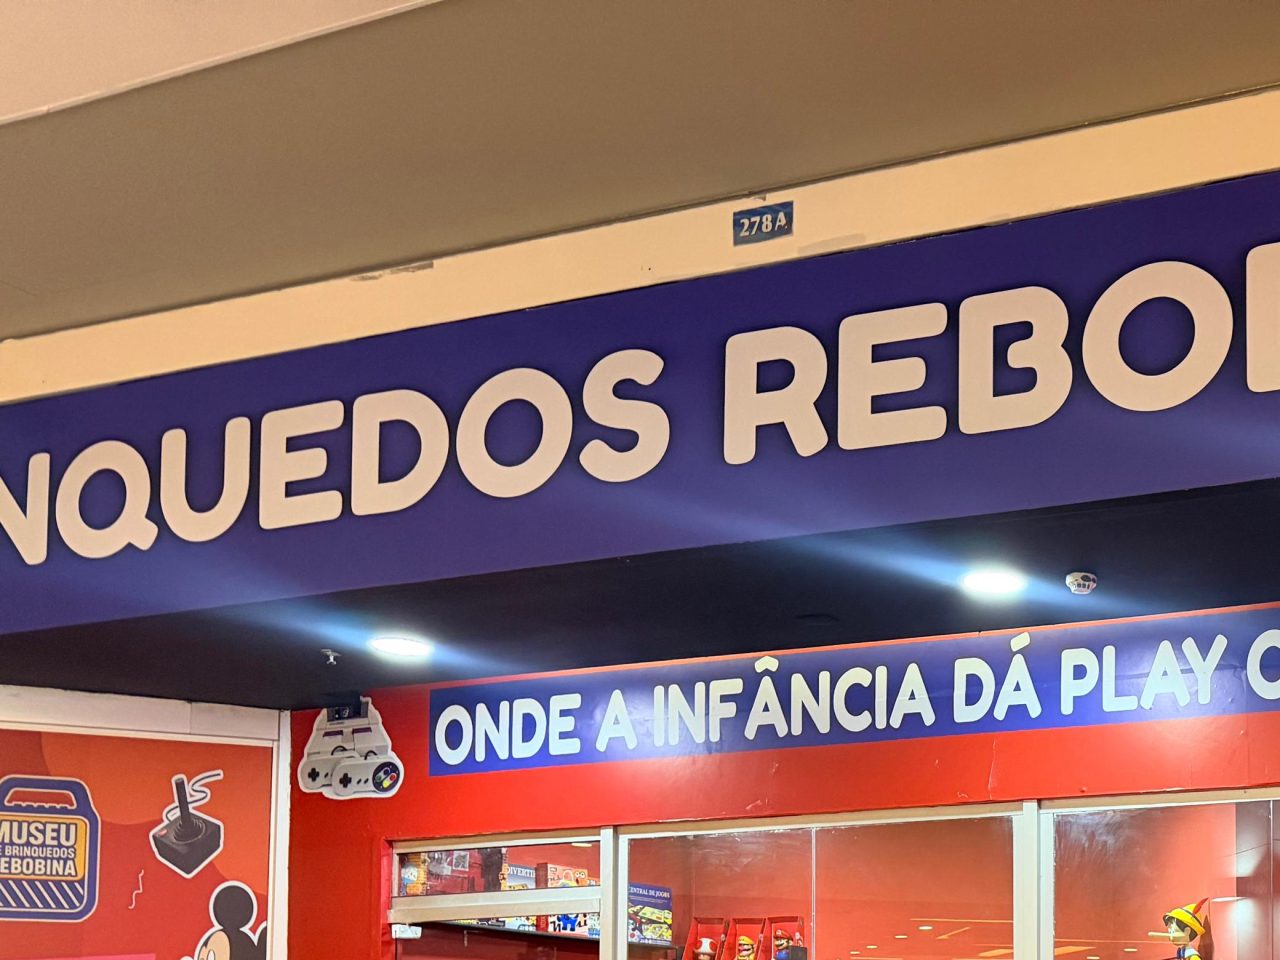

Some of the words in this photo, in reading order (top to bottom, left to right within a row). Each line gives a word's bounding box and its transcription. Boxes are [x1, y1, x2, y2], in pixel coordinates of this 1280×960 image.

[435, 692, 582, 765] ONDE
[596, 689, 638, 752] A
[653, 655, 935, 746] INFÂNCIA
[953, 632, 1041, 723] DÁ
[1060, 634, 1228, 715] PLAY
[5, 845, 75, 859] BRINQUEDOS
[506, 866, 536, 877] DIVERTI
[629, 886, 648, 895] ENTRAL
